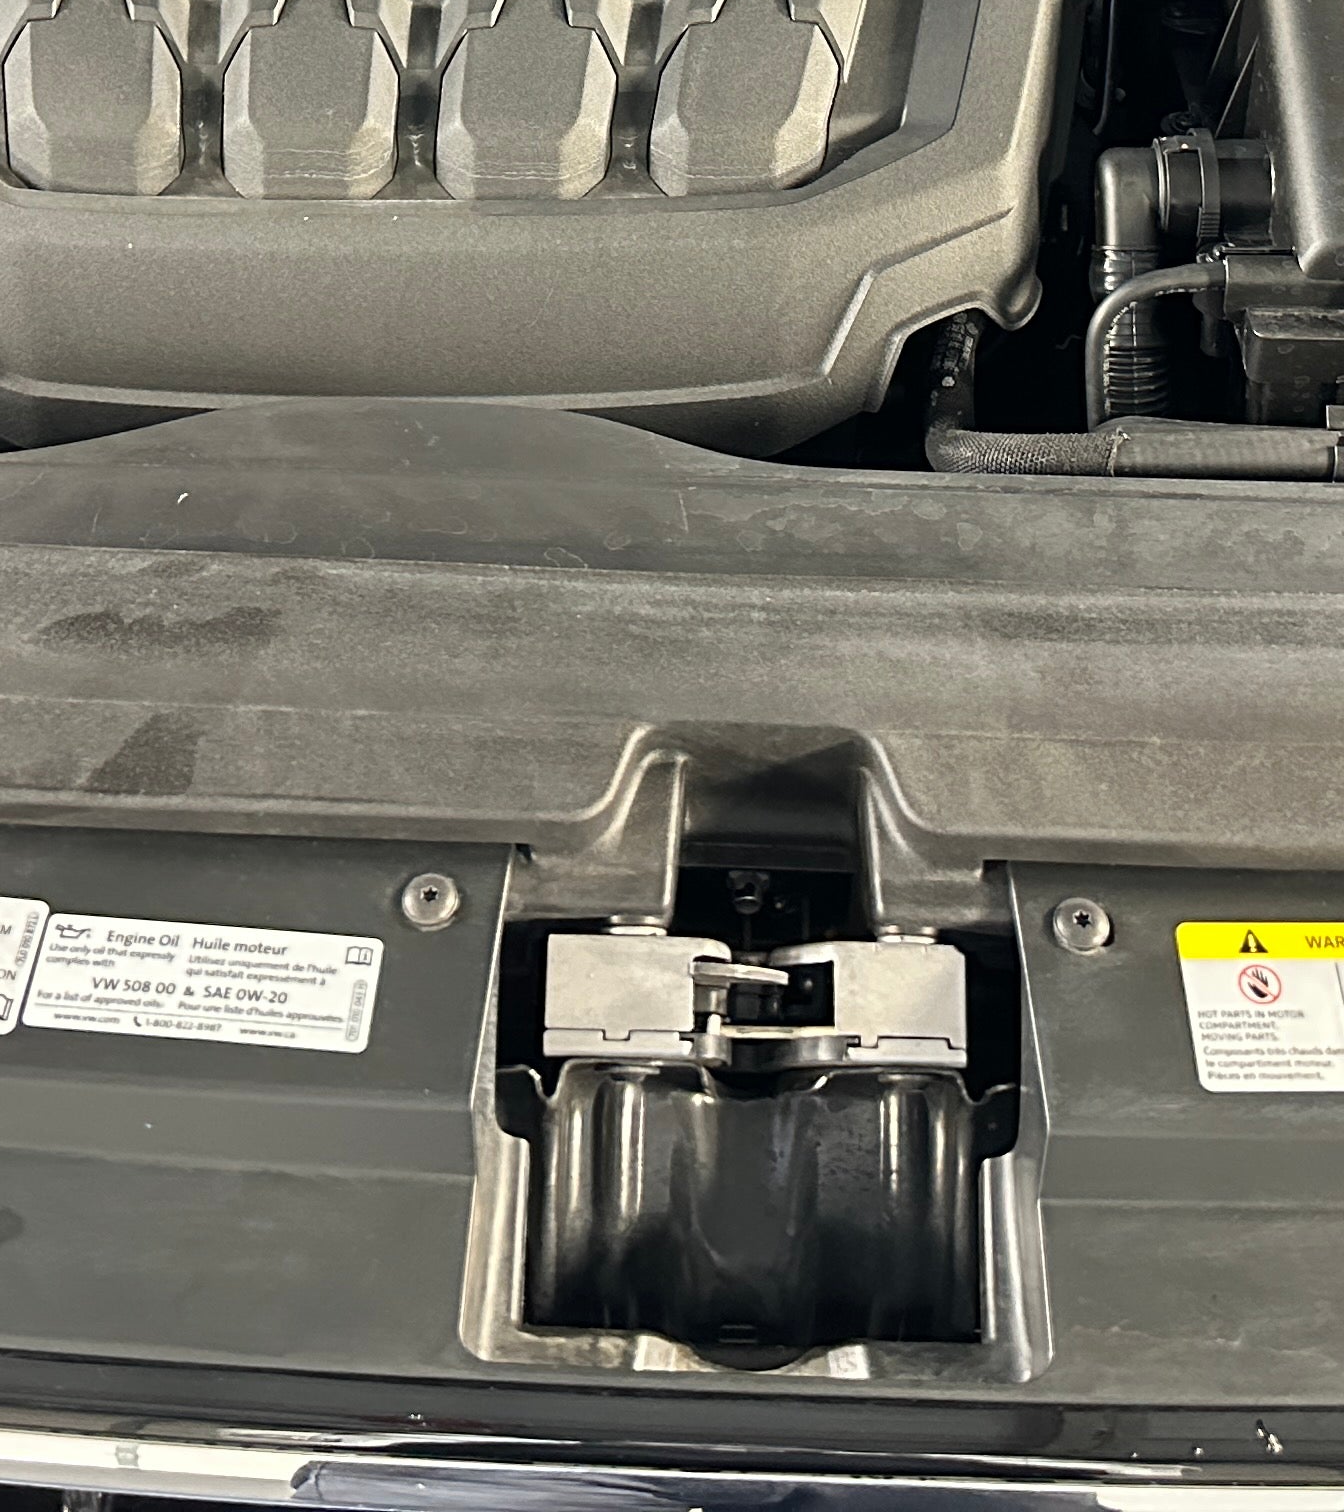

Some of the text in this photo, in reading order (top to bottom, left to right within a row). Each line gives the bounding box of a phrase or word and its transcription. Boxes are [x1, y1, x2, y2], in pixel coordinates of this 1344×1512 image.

[106, 930, 181, 948] Engine Oil
[192, 937, 289, 956] Huile moteur
[49, 943, 176, 961] Use only oil that expressly
[45, 955, 116, 967] complies with
[292, 962, 305, 972] de
[306, 964, 338, 975] l'huile
[186, 967, 203, 977] qui
[204, 968, 244, 980] satisfait
[37, 990, 54, 999] For
[63, 991, 78, 1002] list
[80, 993, 93, 1002] of
[94, 995, 142, 1007] approved
[92, 977, 289, 1004] VW 508 00 & SAE 0W-20
[177, 1000, 201, 1011] Pour
[202, 1004, 222, 1013] une
[223, 1004, 244, 1016] liste
[54, 1013, 121, 1024] www.vw.com
